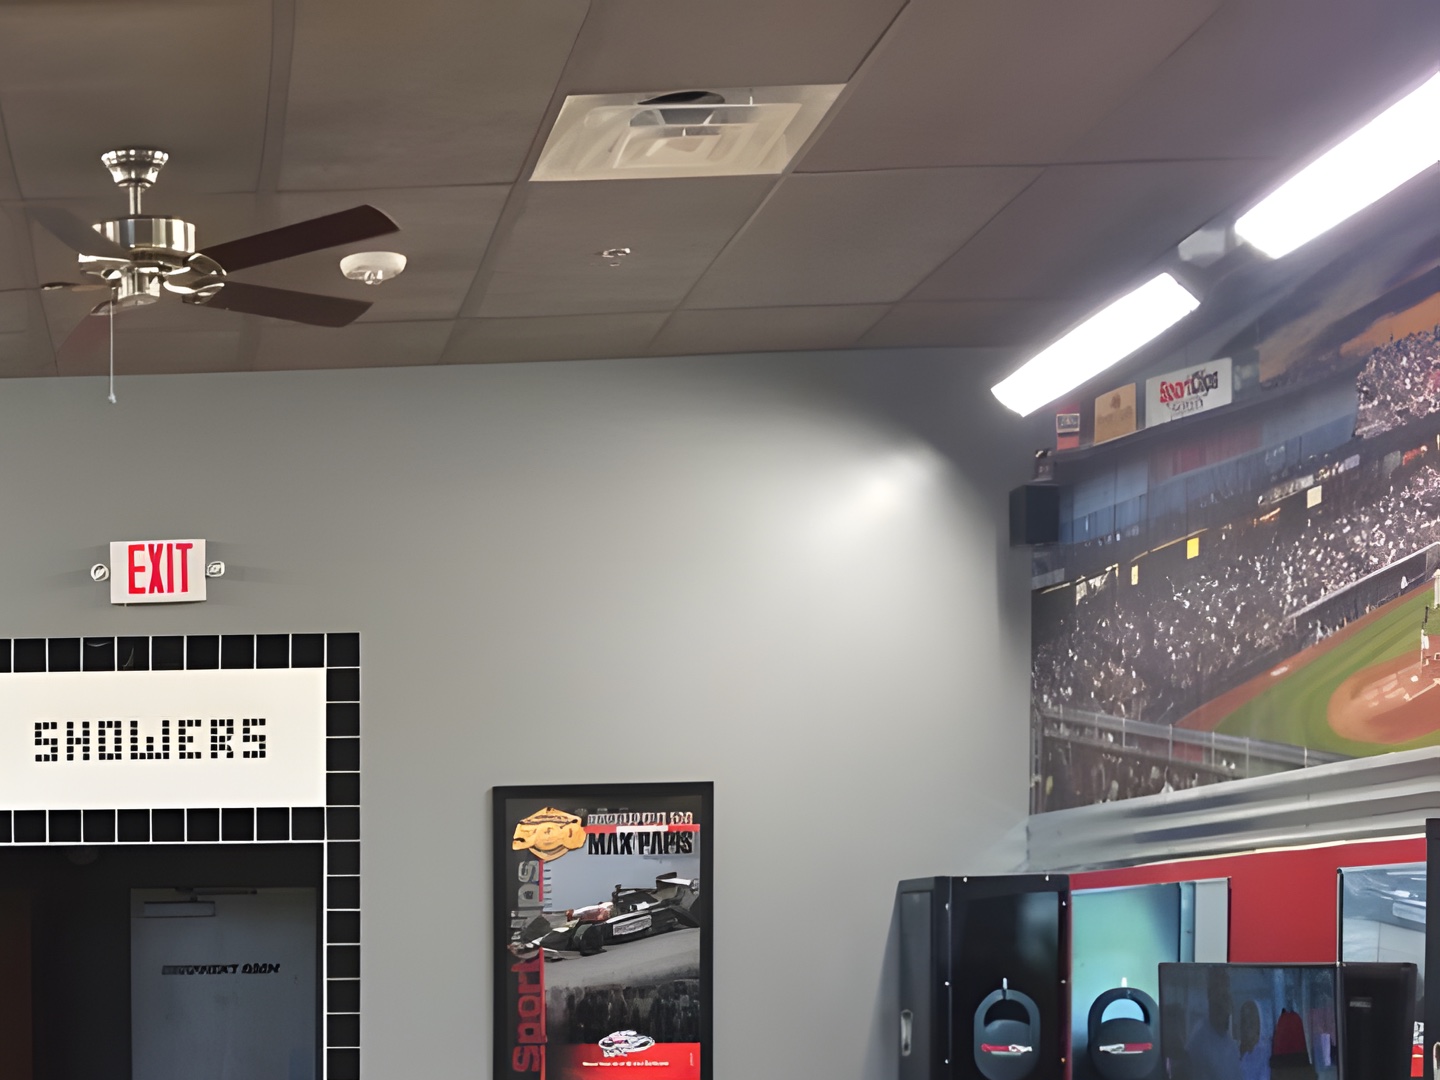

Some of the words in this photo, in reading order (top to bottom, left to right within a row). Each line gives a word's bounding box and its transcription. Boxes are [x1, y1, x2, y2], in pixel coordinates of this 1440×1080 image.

[127, 543, 193, 594] EXIT
[34, 718, 267, 762] SHOWERS
[588, 831, 634, 855] MAX
